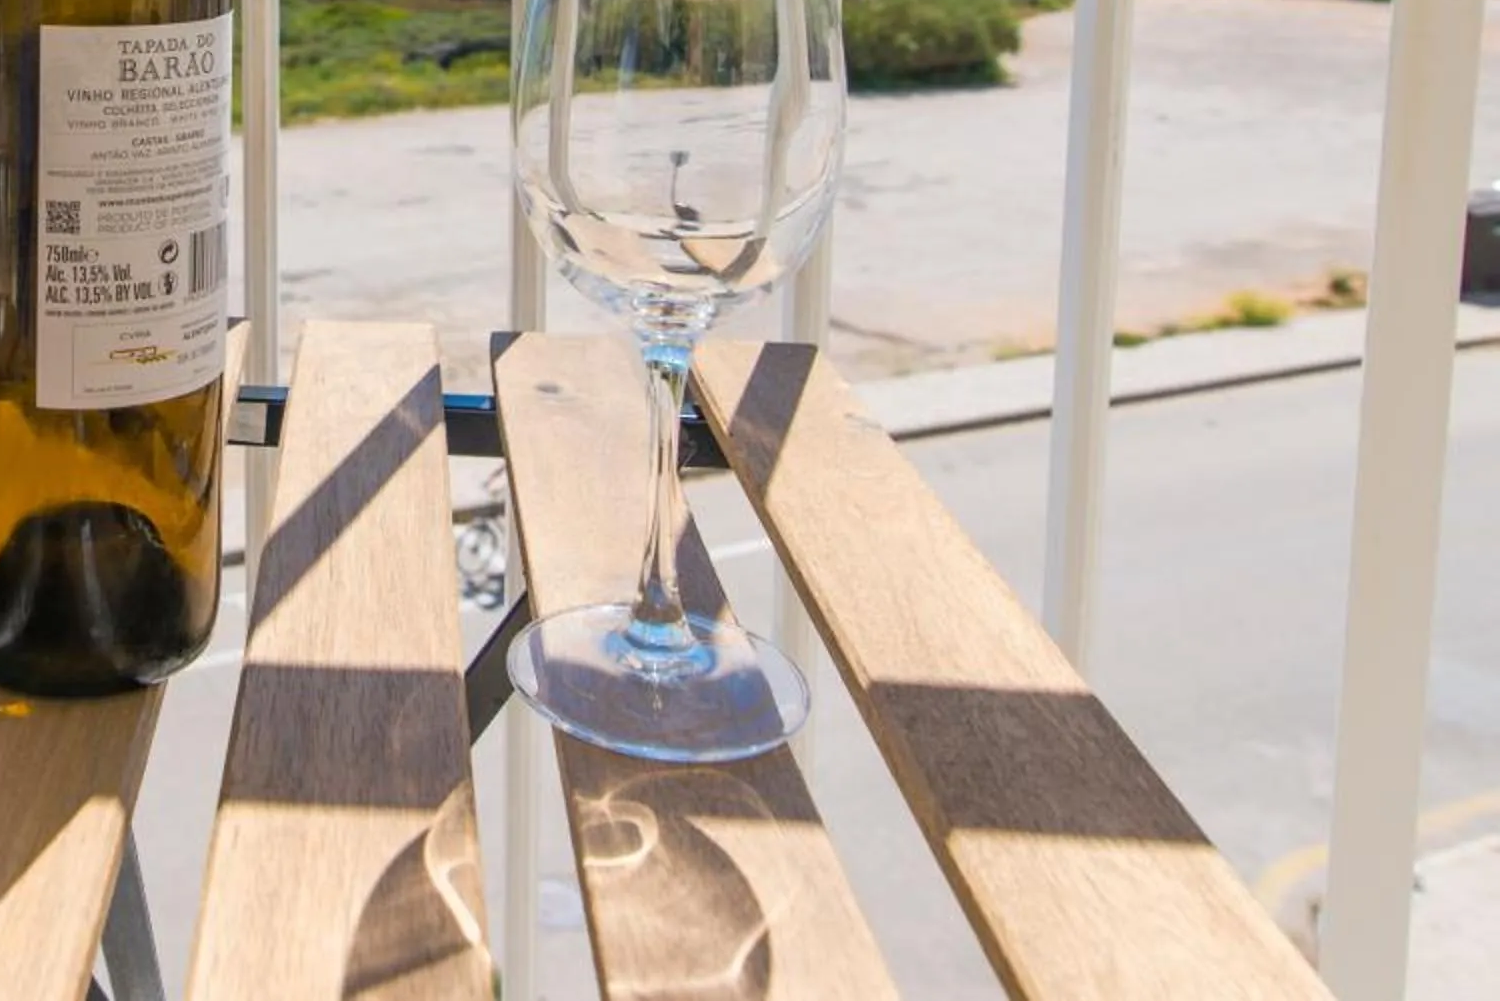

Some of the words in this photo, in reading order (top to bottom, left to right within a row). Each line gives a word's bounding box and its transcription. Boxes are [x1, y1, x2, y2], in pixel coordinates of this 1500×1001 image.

[118, 38, 188, 54] TAPADA
[196, 33, 216, 49] DO
[67, 89, 113, 102] VINHO
[121, 86, 184, 100] REGIONAL
[45, 264, 68, 283] Alc.
[72, 264, 110, 284] 13,5%
[45, 285, 70, 304] ALC.
[115, 283, 131, 302] BY
